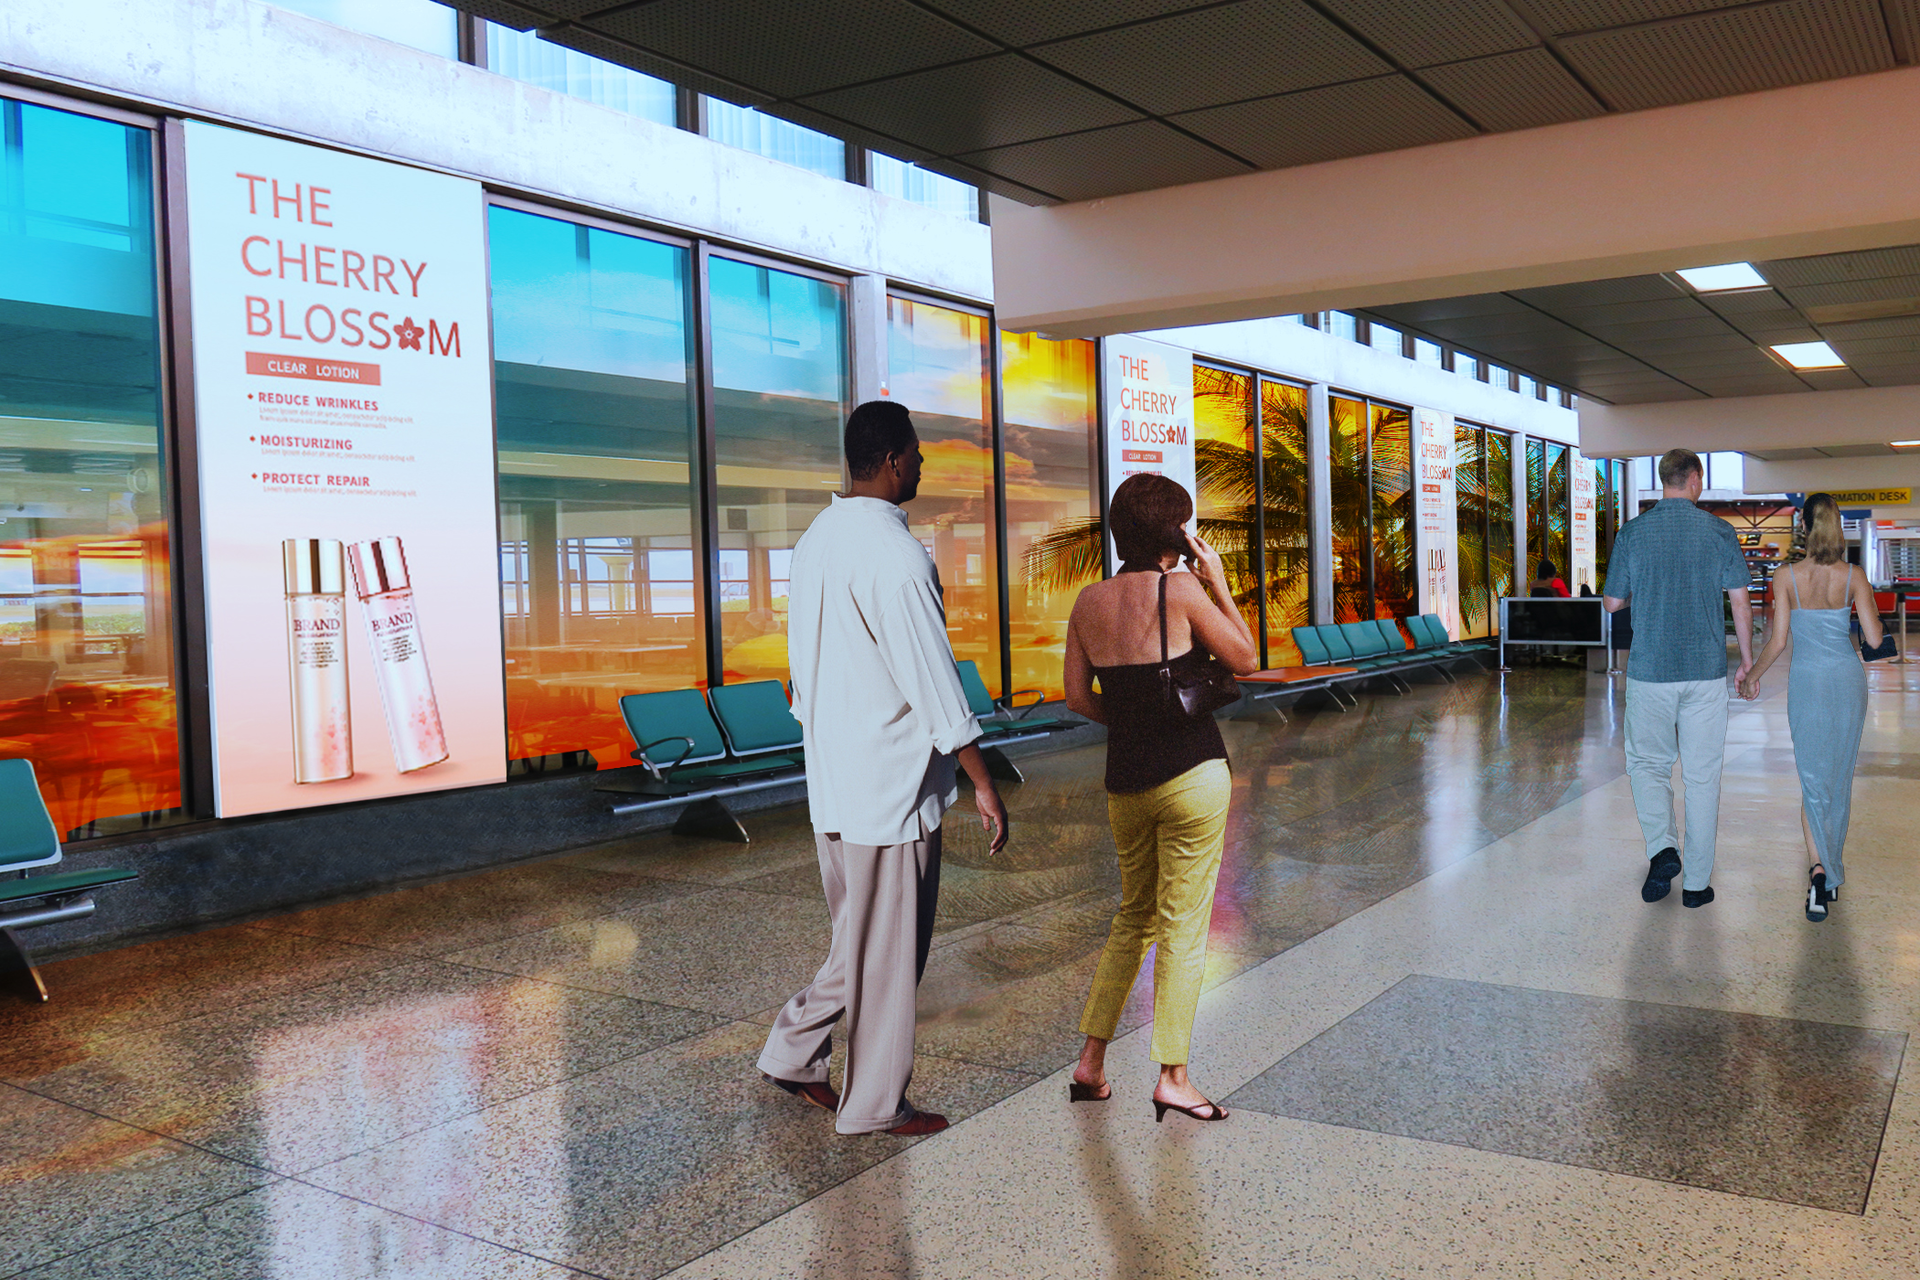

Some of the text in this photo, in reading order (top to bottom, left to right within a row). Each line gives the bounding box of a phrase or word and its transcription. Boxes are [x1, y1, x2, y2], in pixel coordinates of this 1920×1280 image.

[236, 171, 333, 228] THE
[241, 235, 427, 298] CHERRY
[267, 360, 360, 380] CLEAR LOTION
[1119, 355, 1149, 381] THE
[258, 391, 379, 412] REDUCE WRINKLES
[1121, 388, 1177, 415] CHERRY
[1420, 421, 1434, 437] THE
[260, 434, 353, 450] MOISTURIZING
[1421, 442, 1448, 459] CHERRY
[262, 472, 370, 487] PROTECT REPAIR
[1831, 491, 1908, 502] RMATION DESK
[293, 618, 341, 631] BRAND
[371, 612, 413, 632] BRAND
